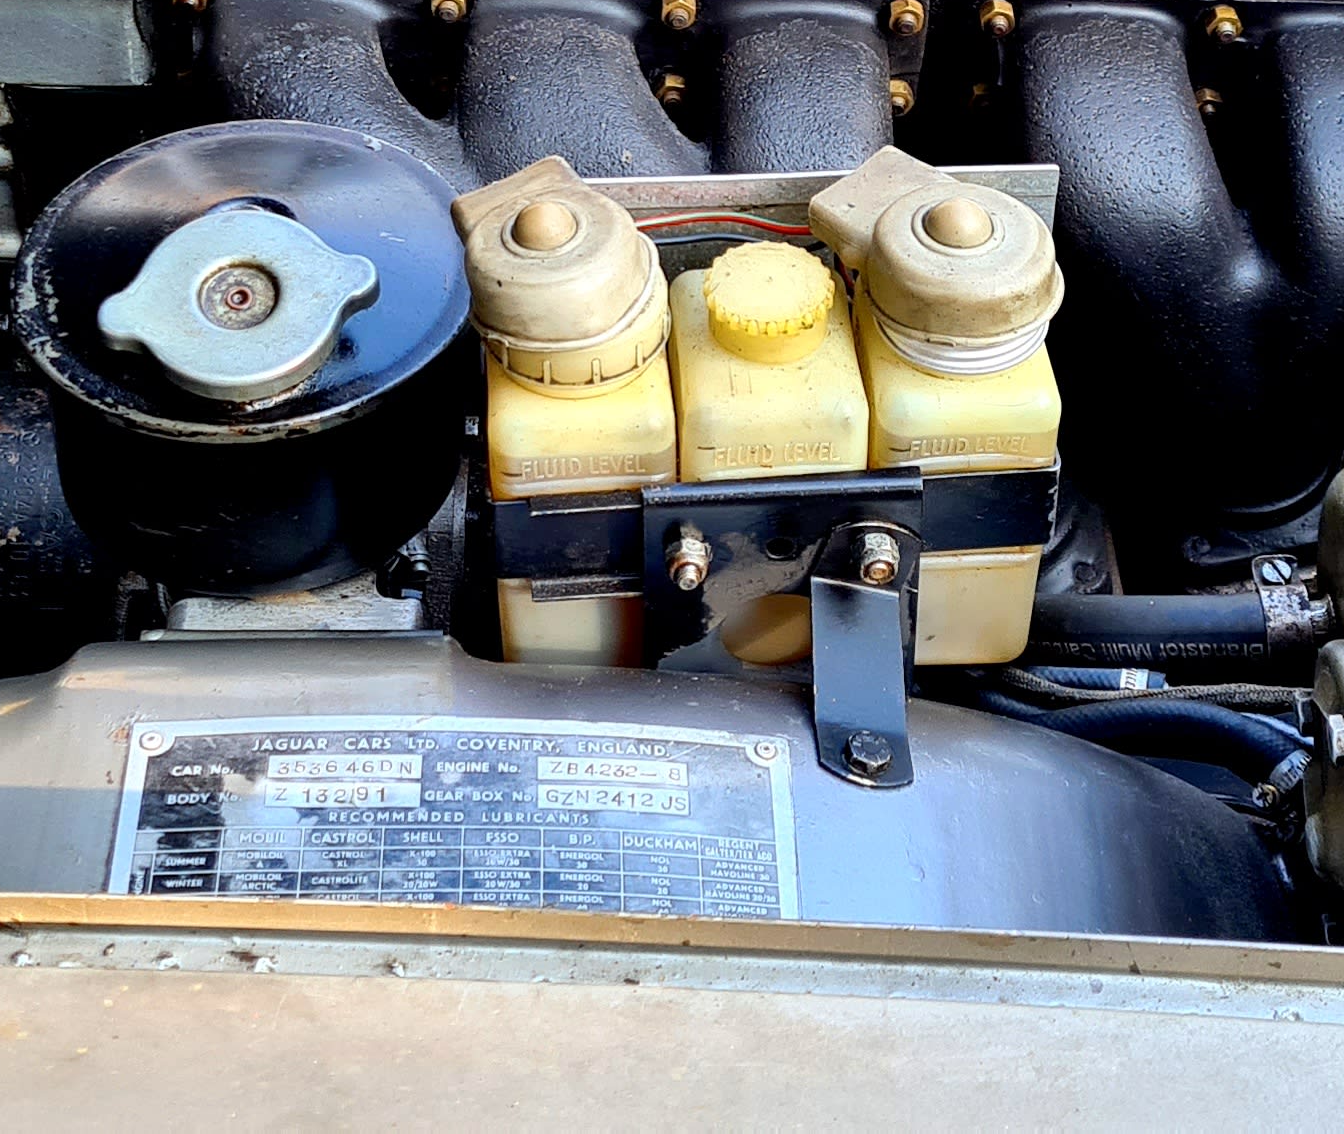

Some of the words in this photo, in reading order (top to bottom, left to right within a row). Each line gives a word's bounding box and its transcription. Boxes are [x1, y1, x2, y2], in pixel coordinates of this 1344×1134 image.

[910, 438, 969, 457] FLUID
[975, 435, 1029, 454] LEVEL
[784, 441, 841, 463] LEVEL
[521, 457, 581, 480] FLUID
[589, 454, 647, 475] LEVEL
[252, 738, 328, 752] JAGUAR
[344, 737, 392, 751] CARS
[171, 765, 203, 777] CAR
[436, 761, 490, 774] ENGINE
[498, 762, 521, 774] No.
[166, 791, 211, 806] BODY
[424, 791, 464, 802] GEAR
[472, 790, 504, 802] BOX
[328, 810, 465, 824] RECOMMENDED
[481, 811, 590, 826] LUBRICANTS
[239, 832, 287, 844] MOBIL
[311, 832, 376, 844] CASTROL
[402, 831, 444, 843] SHELL
[485, 832, 520, 843] ESSO
[568, 834, 596, 845] B.P.
[624, 835, 698, 851] DUCKHAM
[237, 850, 284, 859] MOBILOIL
[322, 851, 365, 859] CASTROL
[500, 850, 531, 858] EXTRA
[559, 852, 605, 861] ENERGOL
[165, 857, 206, 867] SUMMER
[336, 860, 348, 868] XL
[650, 855, 671, 865] NOL
[715, 861, 765, 872] ADVANCED
[235, 872, 283, 882] MOBILOIL
[311, 876, 369, 885] CASTROLITE
[473, 872, 497, 880] ESSO
[500, 872, 531, 880] EXTRA
[559, 873, 605, 883] ENERGOL
[164, 878, 203, 888] WINTER
[241, 882, 277, 891] ARCTIC
[650, 877, 671, 887] NOL
[715, 883, 766, 894] ADVANCED
[473, 893, 497, 901] ESSO
[500, 893, 531, 901] EXTRA
[559, 894, 605, 904] ENERGOL
[652, 899, 672, 908] NOL
[718, 904, 768, 915] ADVANCED
